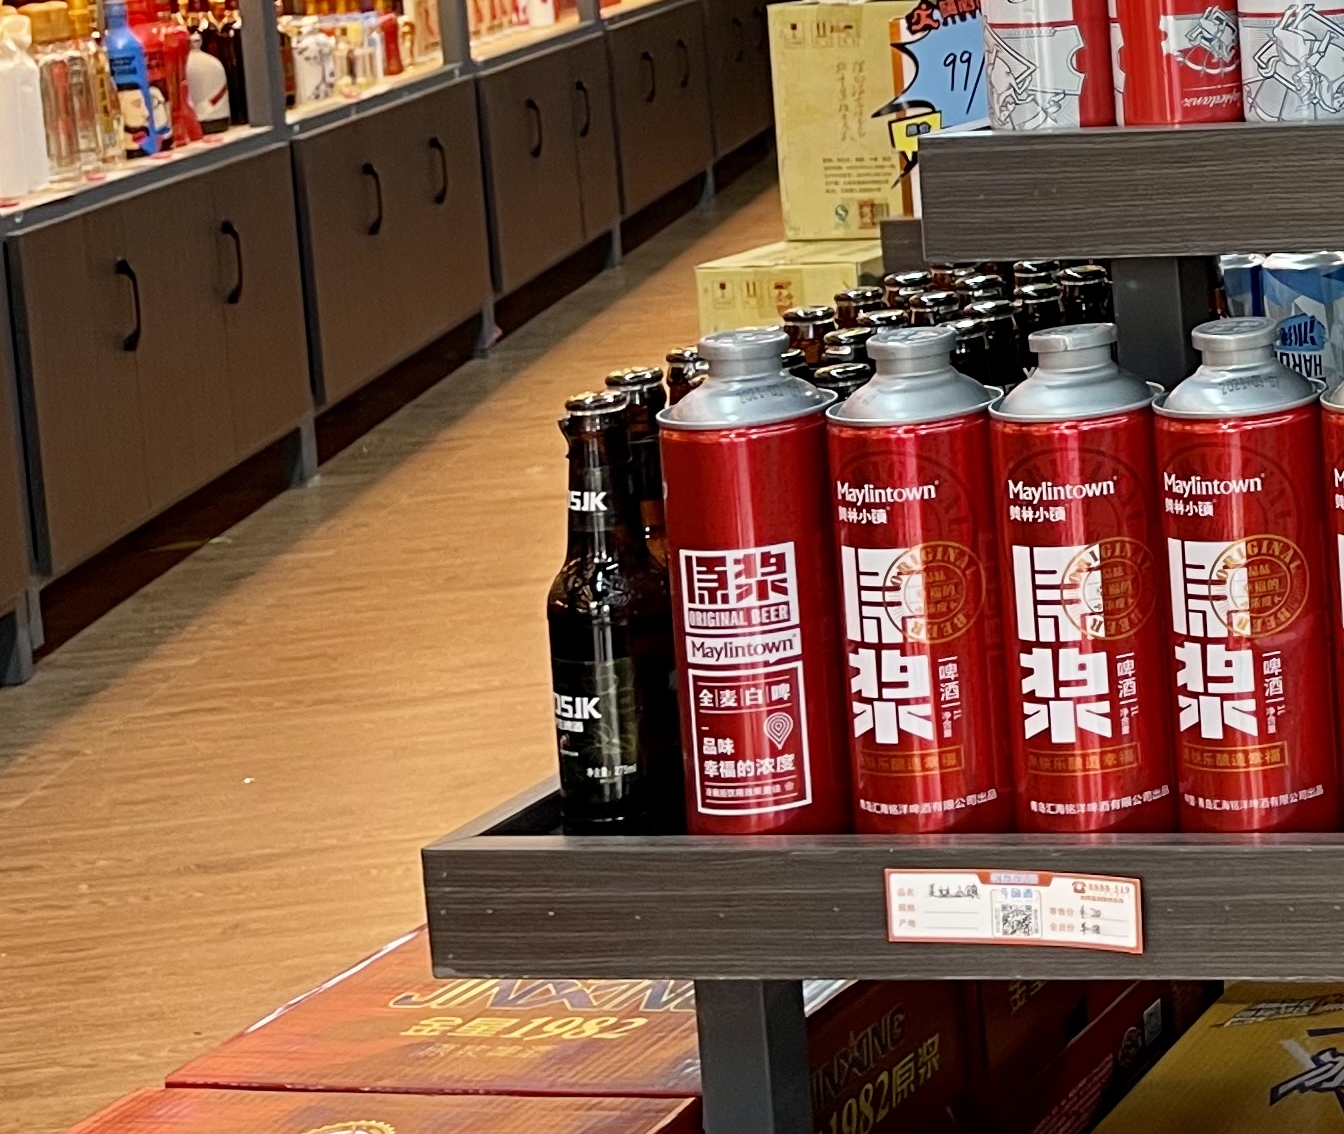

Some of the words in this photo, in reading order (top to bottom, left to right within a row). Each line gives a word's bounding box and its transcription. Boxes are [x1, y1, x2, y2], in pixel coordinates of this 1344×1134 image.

[836, 480, 936, 505] Maylintown
[1008, 478, 1115, 502] Maylintown
[1164, 472, 1262, 497] Maylintown
[685, 551, 790, 606] 原浆
[689, 608, 747, 629] ORIGINAL
[751, 604, 790, 626] BEER
[690, 635, 795, 665] Maylintown
[703, 754, 795, 780] 幸福的浓度
